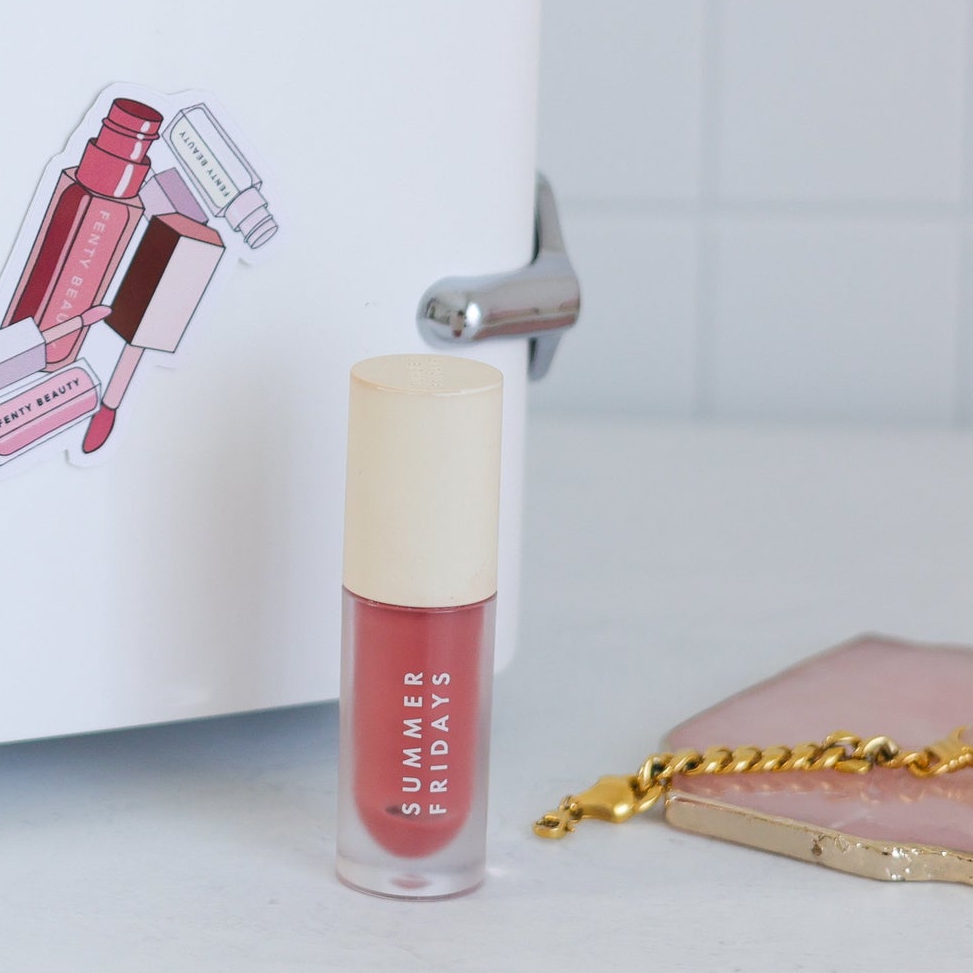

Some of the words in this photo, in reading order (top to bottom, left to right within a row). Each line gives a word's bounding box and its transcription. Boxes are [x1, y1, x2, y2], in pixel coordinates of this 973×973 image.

[179, 130, 209, 167] BEAUTY
[206, 168, 230, 198] FENTY
[80, 210, 111, 269] FENTY
[35, 378, 81, 407] BEAUTY
[401, 671, 424, 816] SUMMER
[429, 671, 451, 816] FRIDAYS
